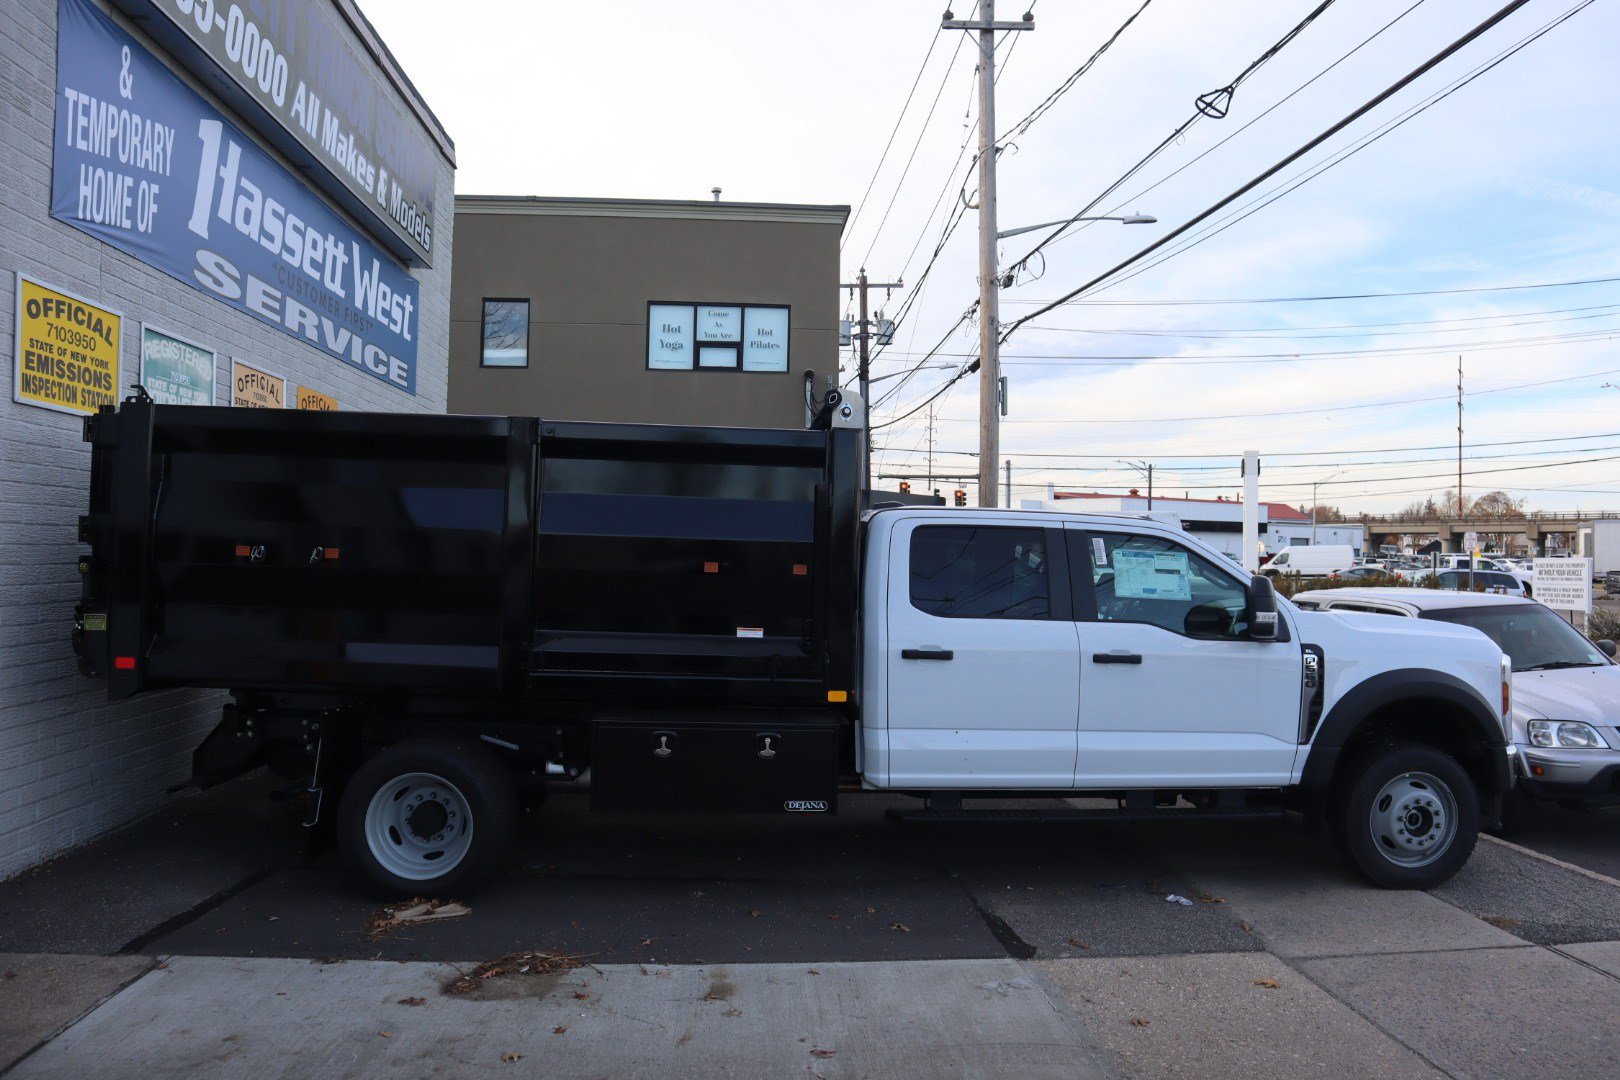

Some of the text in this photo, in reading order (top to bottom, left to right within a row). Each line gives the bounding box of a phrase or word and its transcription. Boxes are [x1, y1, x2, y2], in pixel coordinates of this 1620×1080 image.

[119, 45, 133, 100] &
[65, 87, 175, 176] TEMPORARY
[291, 81, 320, 140] All
[322, 108, 375, 194] Makes
[377, 168, 388, 210] &
[389, 180, 431, 253] Models
[78, 164, 159, 233] HOME OF
[188, 119, 413, 341] Hassett West
[26, 298, 113, 347] OFFICIAL
[194, 249, 408, 387] SERVICE
[662, 323, 681, 334] Hot
[708, 310, 729, 318] Come
[46, 322, 96, 351] 7103950
[659, 339, 684, 351] Yoga
[750, 340, 780, 350] Pilates
[757, 328, 773, 336] Hot
[29, 338, 109, 370] STATE OF NEW YORK
[145, 339, 212, 381] REGISTERED
[25, 350, 112, 391] EMISSIONS
[21, 372, 114, 408] INSPECTION STATION
[148, 377, 168, 391] STATE
[170, 384, 178, 394] OF
[180, 387, 192, 398] NEW
[235, 397, 249, 408] STATE
[237, 374, 280, 404] OFFICIAL
[302, 396, 333, 411] OFFICI
[788, 801, 824, 810] DEJANA
